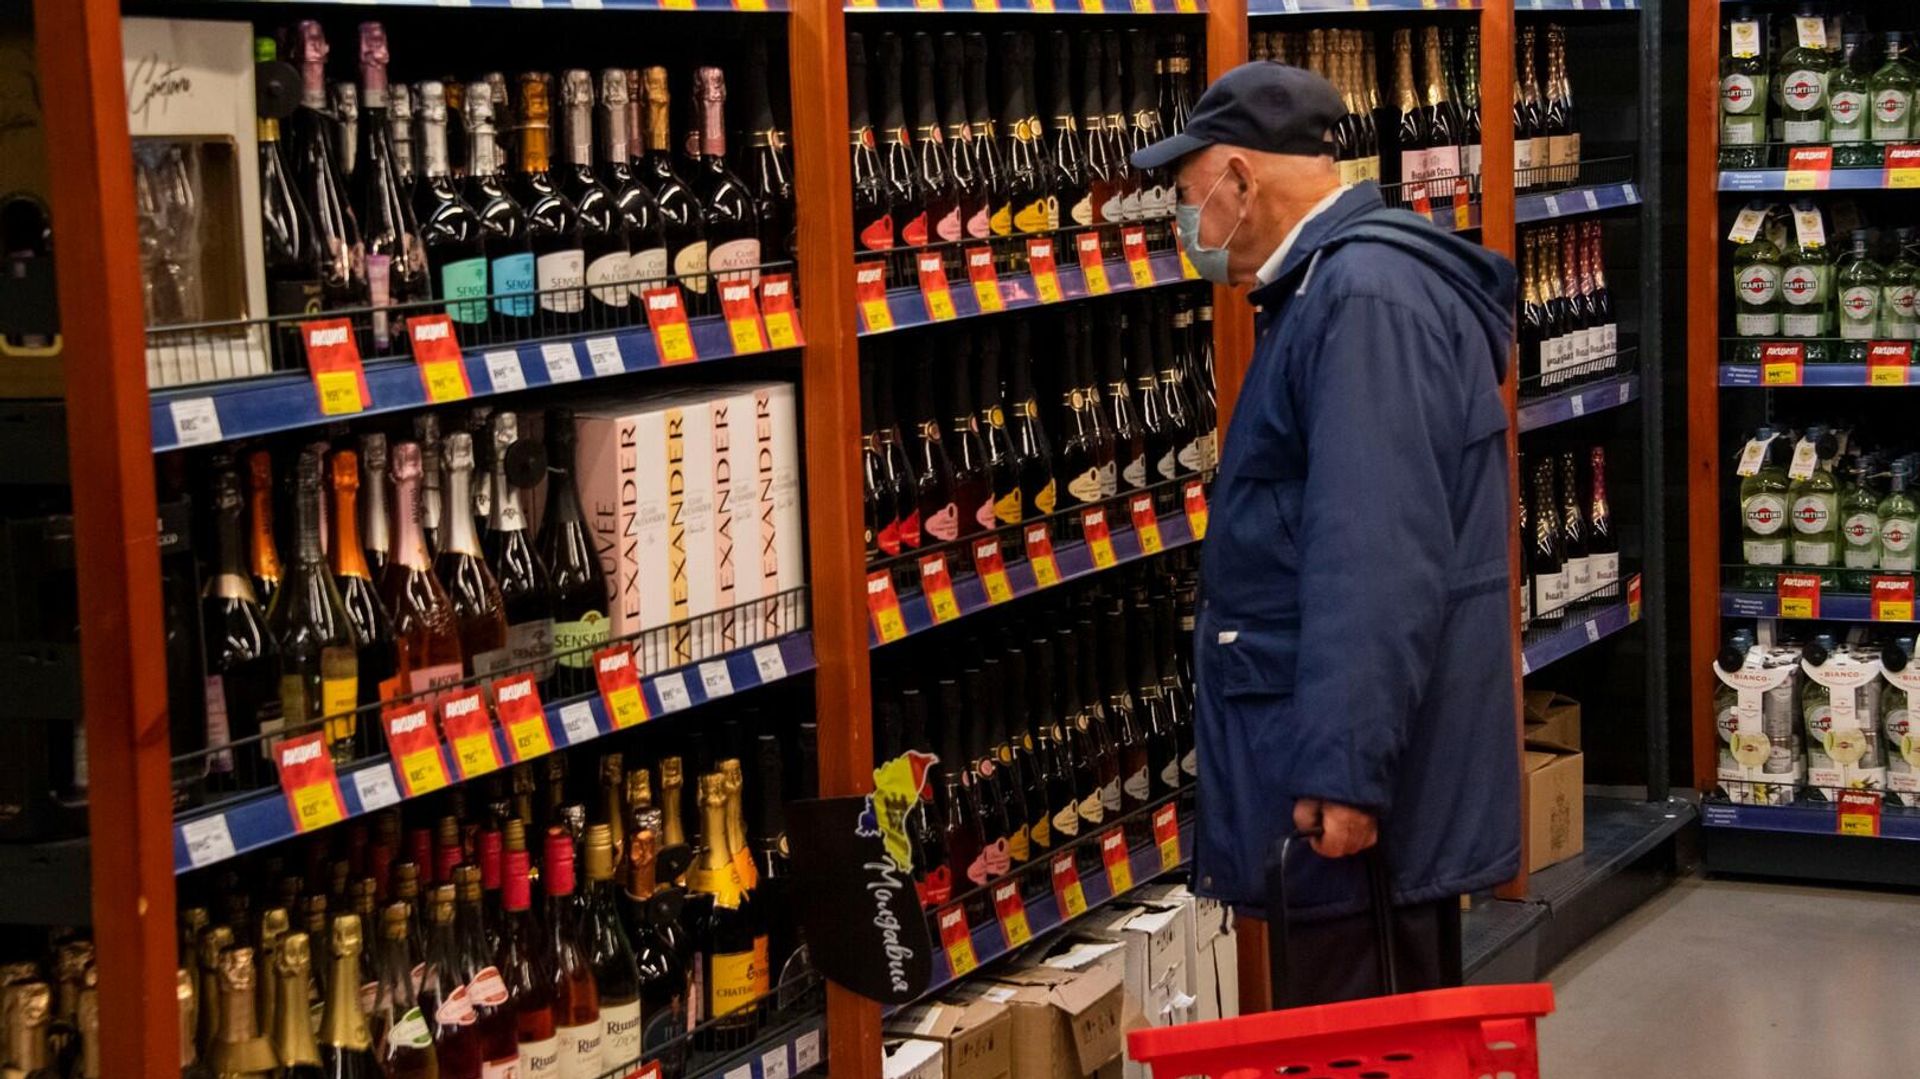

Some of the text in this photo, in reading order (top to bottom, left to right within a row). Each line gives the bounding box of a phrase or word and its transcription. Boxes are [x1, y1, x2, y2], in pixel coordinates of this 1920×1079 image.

[1785, 86, 1820, 95] MARTINI
[1831, 103, 1859, 111] MARTINI
[1741, 281, 1774, 289] MARTINI
[1783, 281, 1816, 289] MARTINI
[1748, 511, 1781, 520] MARTINI
[1794, 511, 1827, 519] MARTINI
[621, 425, 643, 676] EXANDER
[1733, 674, 1767, 682] BIANCO
[863, 855, 914, 993] Молдавия
